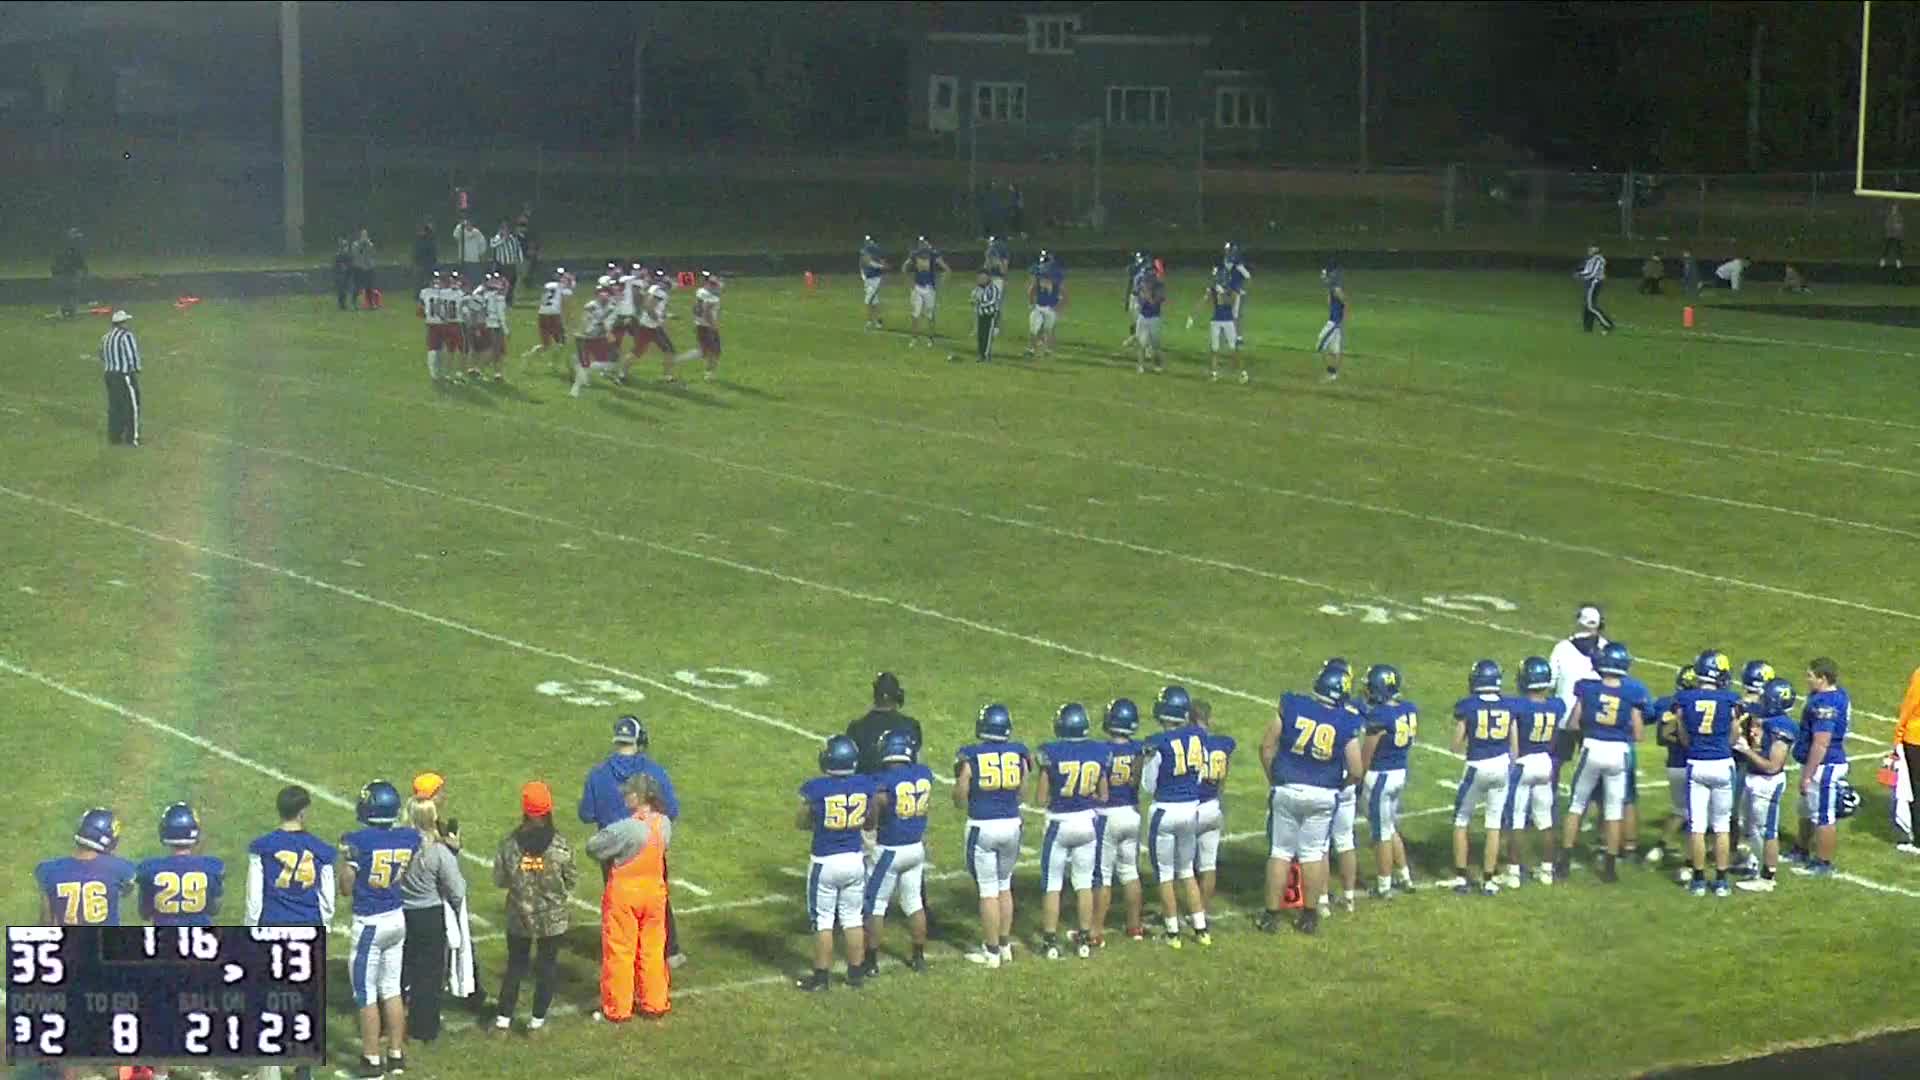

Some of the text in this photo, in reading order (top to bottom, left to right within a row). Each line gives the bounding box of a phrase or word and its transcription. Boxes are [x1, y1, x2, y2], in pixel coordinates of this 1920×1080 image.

[1475, 710, 1510, 739] 13
[1529, 712, 1556, 742] 11
[1596, 694, 1620, 725] 3
[1695, 700, 1717, 734] 7
[1291, 715, 1336, 760] 79
[977, 752, 1020, 790] 56
[1111, 754, 1133, 785] 5
[1170, 735, 1204, 783] 14
[895, 778, 931, 818] 62
[1059, 761, 1101, 797] 70
[824, 793, 868, 830] 52
[274, 850, 316, 888] 74
[368, 848, 412, 888] 57
[56, 881, 109, 925] 76
[154, 872, 208, 913] 29
